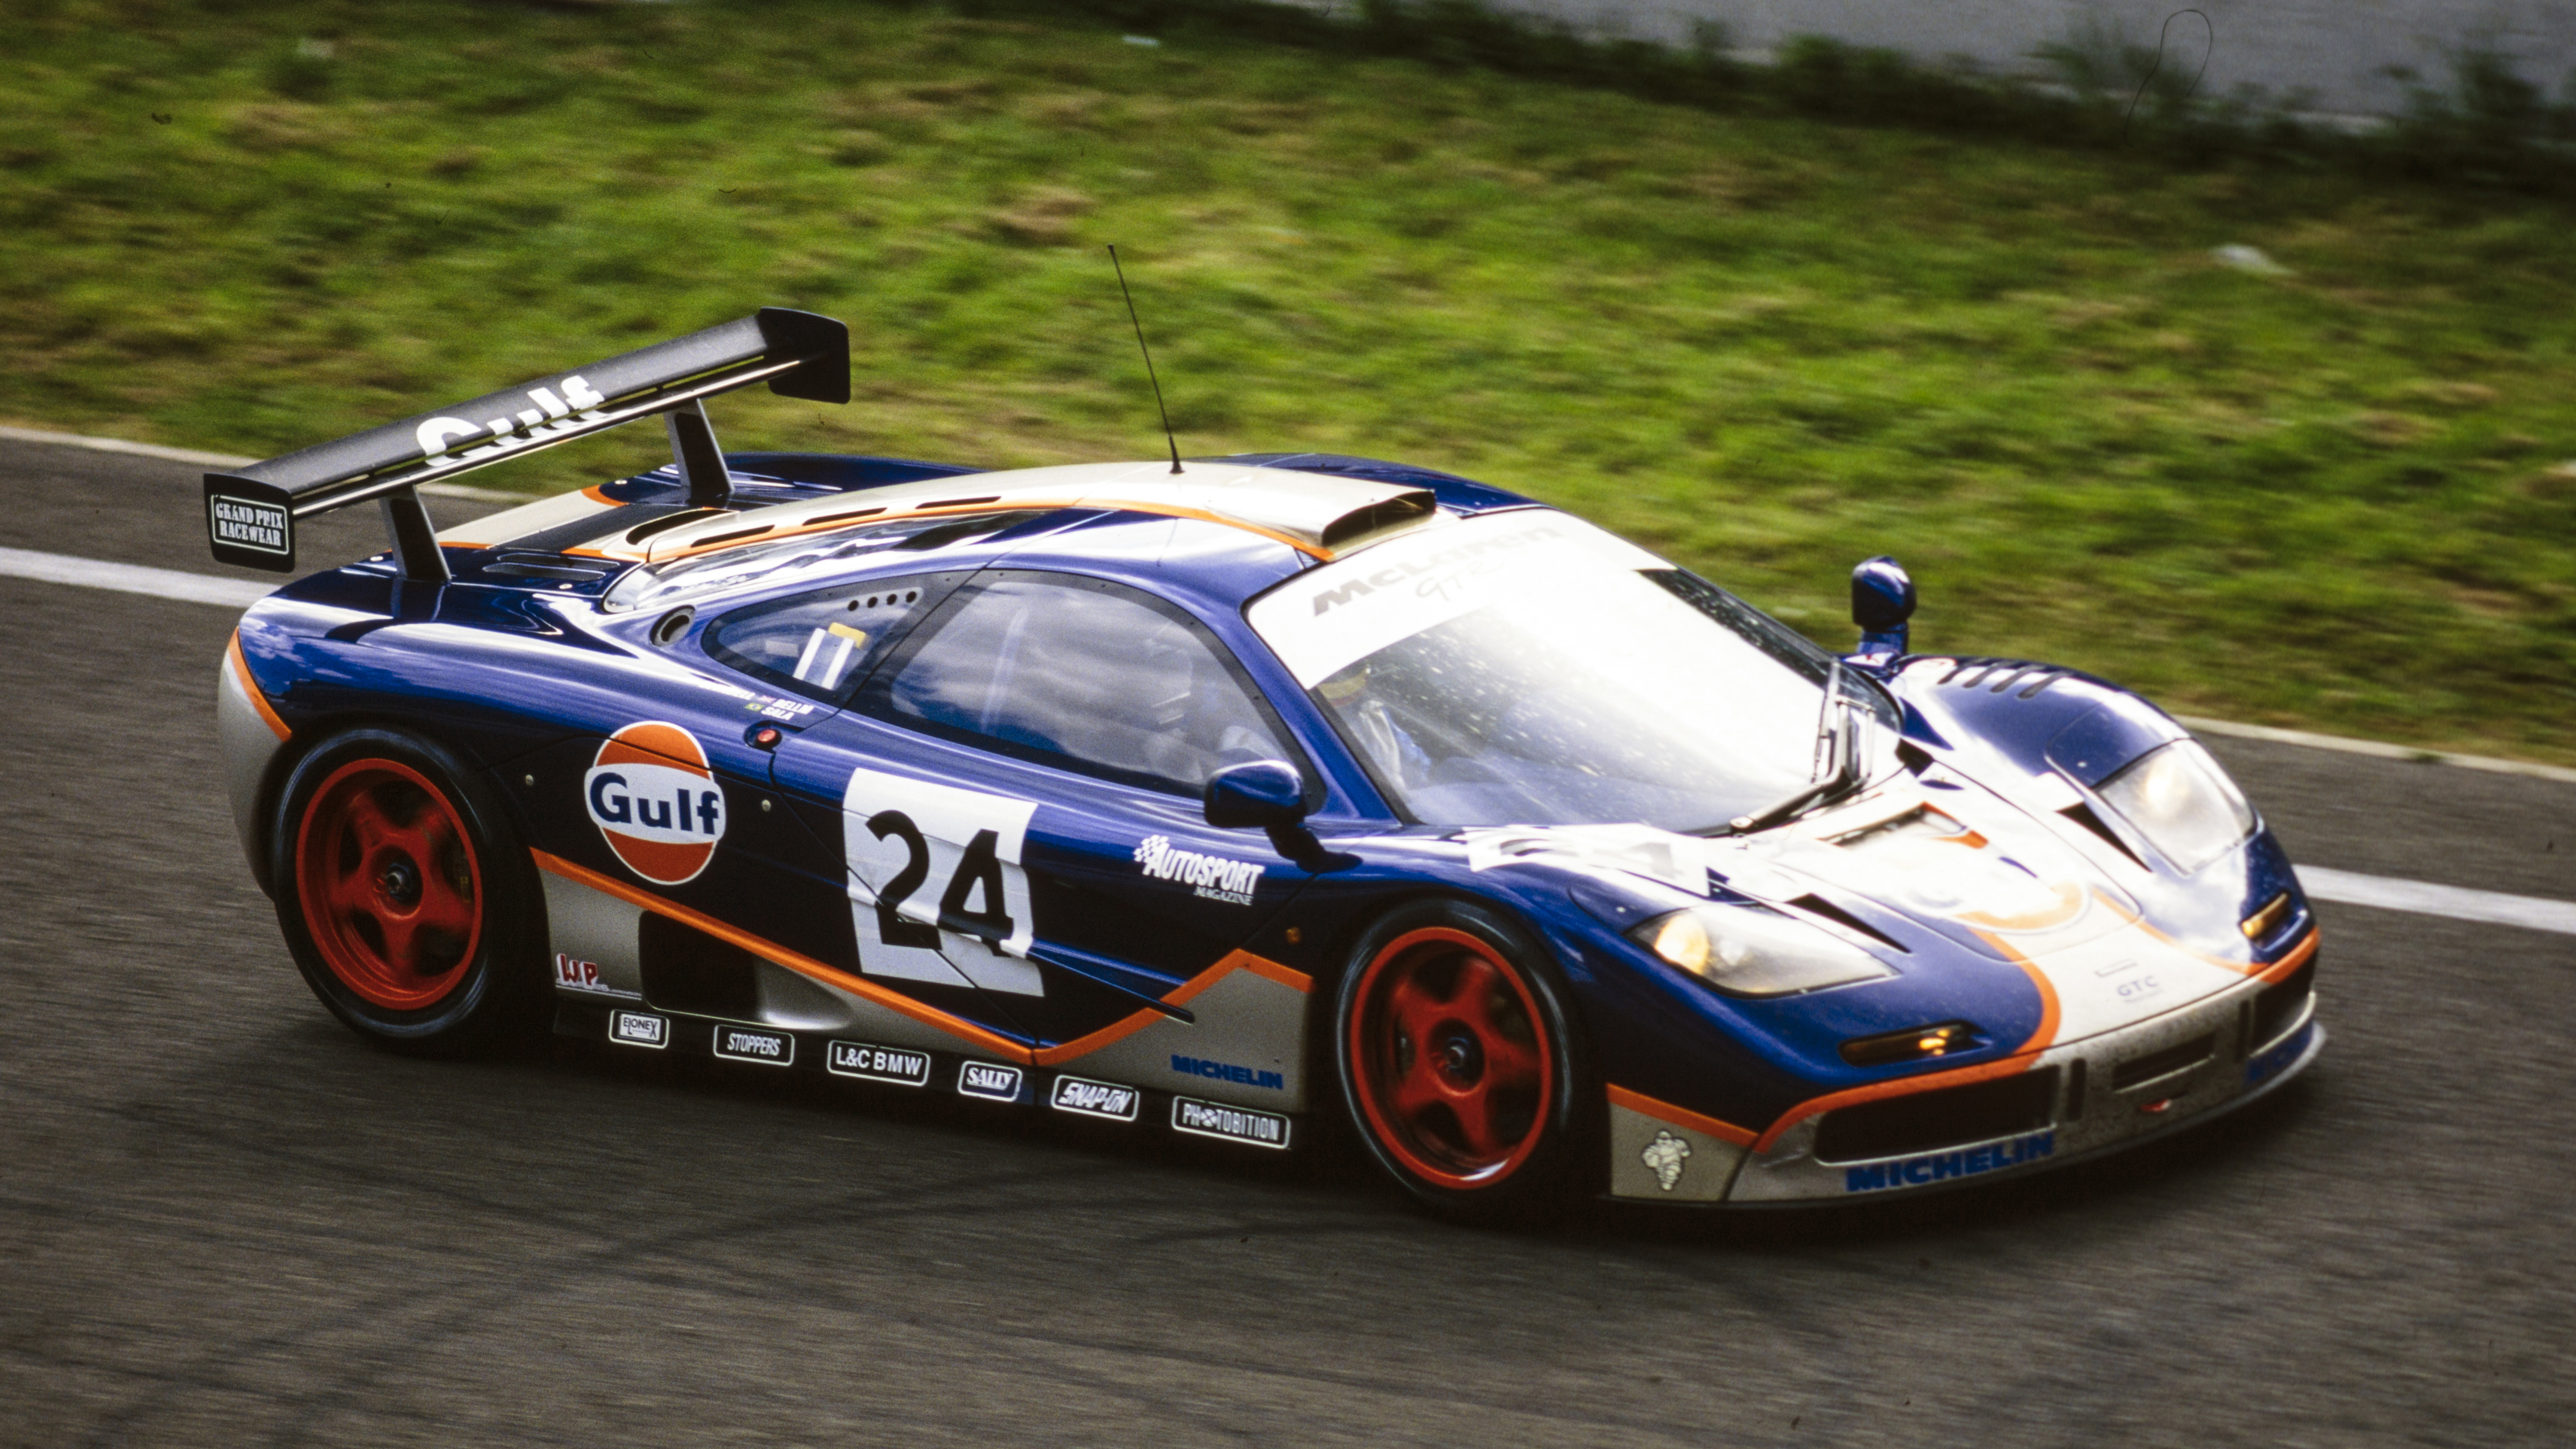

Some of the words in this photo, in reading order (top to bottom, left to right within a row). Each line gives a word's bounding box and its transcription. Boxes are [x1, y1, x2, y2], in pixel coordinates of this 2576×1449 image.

[216, 503, 254, 524] GRAND
[255, 509, 284, 529] PRIX
[219, 520, 281, 546] RACEWEAR
[761, 706, 795, 720] SALA
[590, 772, 719, 835] Gulf
[1142, 842, 1265, 895] AUTOSPORT
[865, 810, 1014, 957] 24
[1193, 886, 1254, 906] MAGAZINE
[2116, 975, 2159, 996] GTC
[727, 1033, 781, 1056] STOPPERS
[836, 1046, 870, 1069] L&C
[873, 1051, 923, 1075] BMW
[1171, 1054, 1284, 1090] MICHELIN
[1846, 1132, 2054, 1193] MICHELIN
